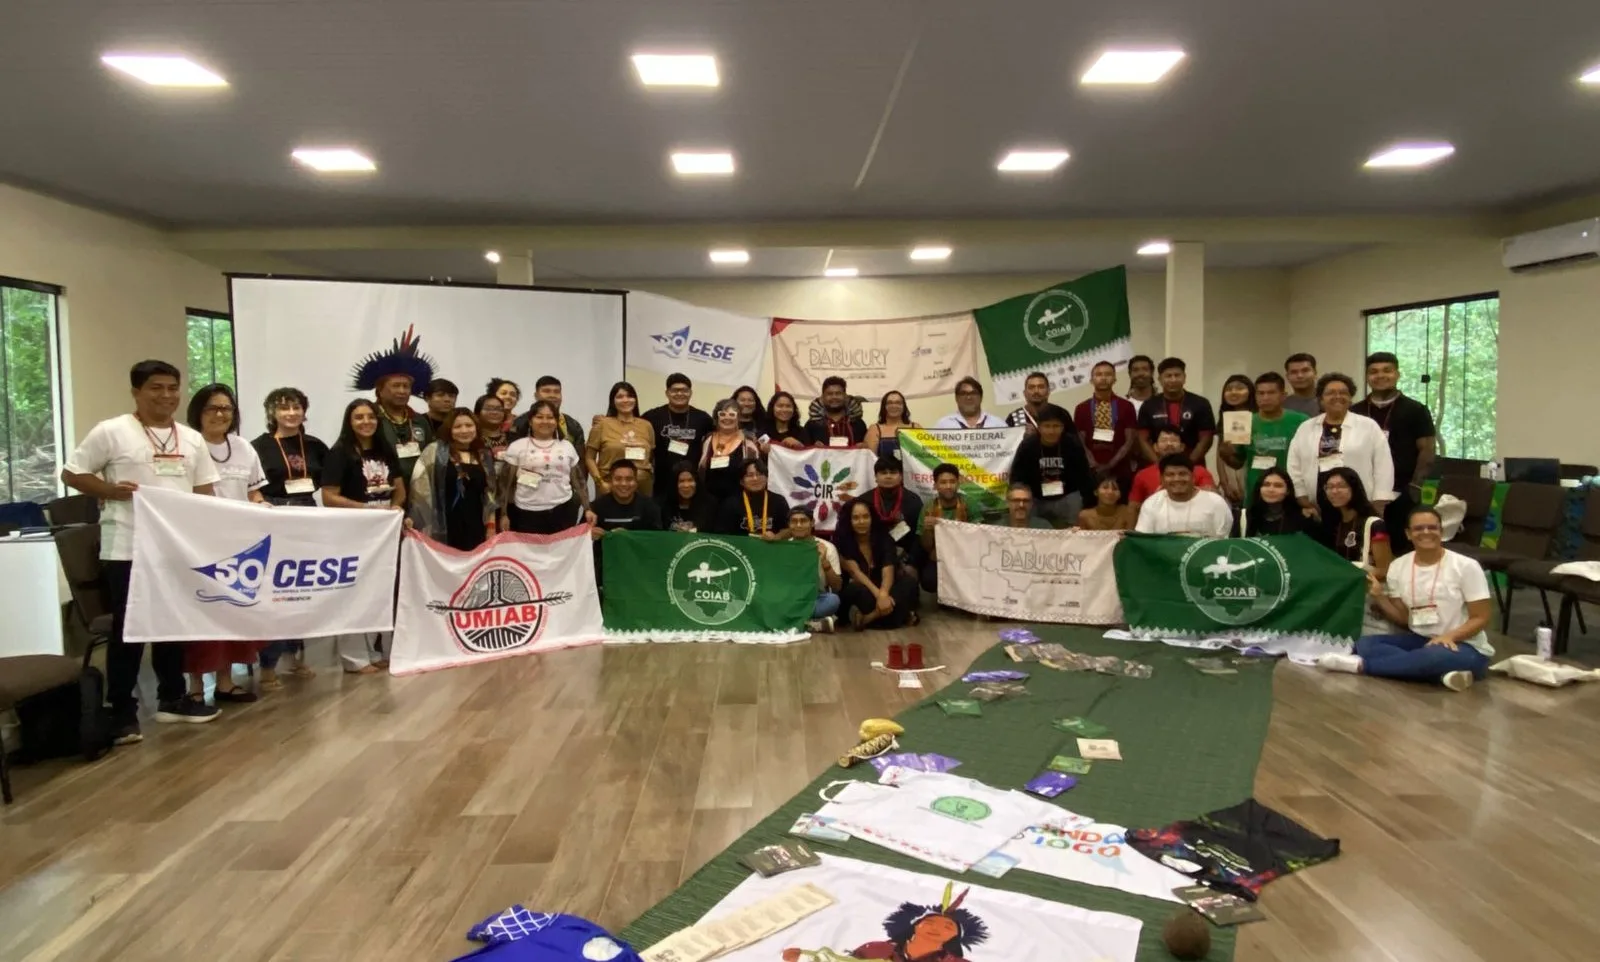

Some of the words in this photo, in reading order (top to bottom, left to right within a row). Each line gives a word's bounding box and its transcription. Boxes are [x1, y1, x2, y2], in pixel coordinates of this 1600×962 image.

[1045, 323, 1072, 338] COIAB
[688, 339, 735, 361] CESE
[809, 347, 889, 367] DABUCURY
[916, 432, 962, 441] GOVERNO
[964, 431, 1006, 440] FEDERAL
[1038, 456, 1064, 469] NIKE
[814, 483, 834, 499] CIR
[1001, 549, 1087, 572] DABUCURY
[214, 557, 265, 589] 50
[272, 556, 359, 588] CESE
[694, 589, 730, 600] COIAB
[1213, 586, 1257, 597] COIAB
[455, 605, 538, 629] UMIAB
